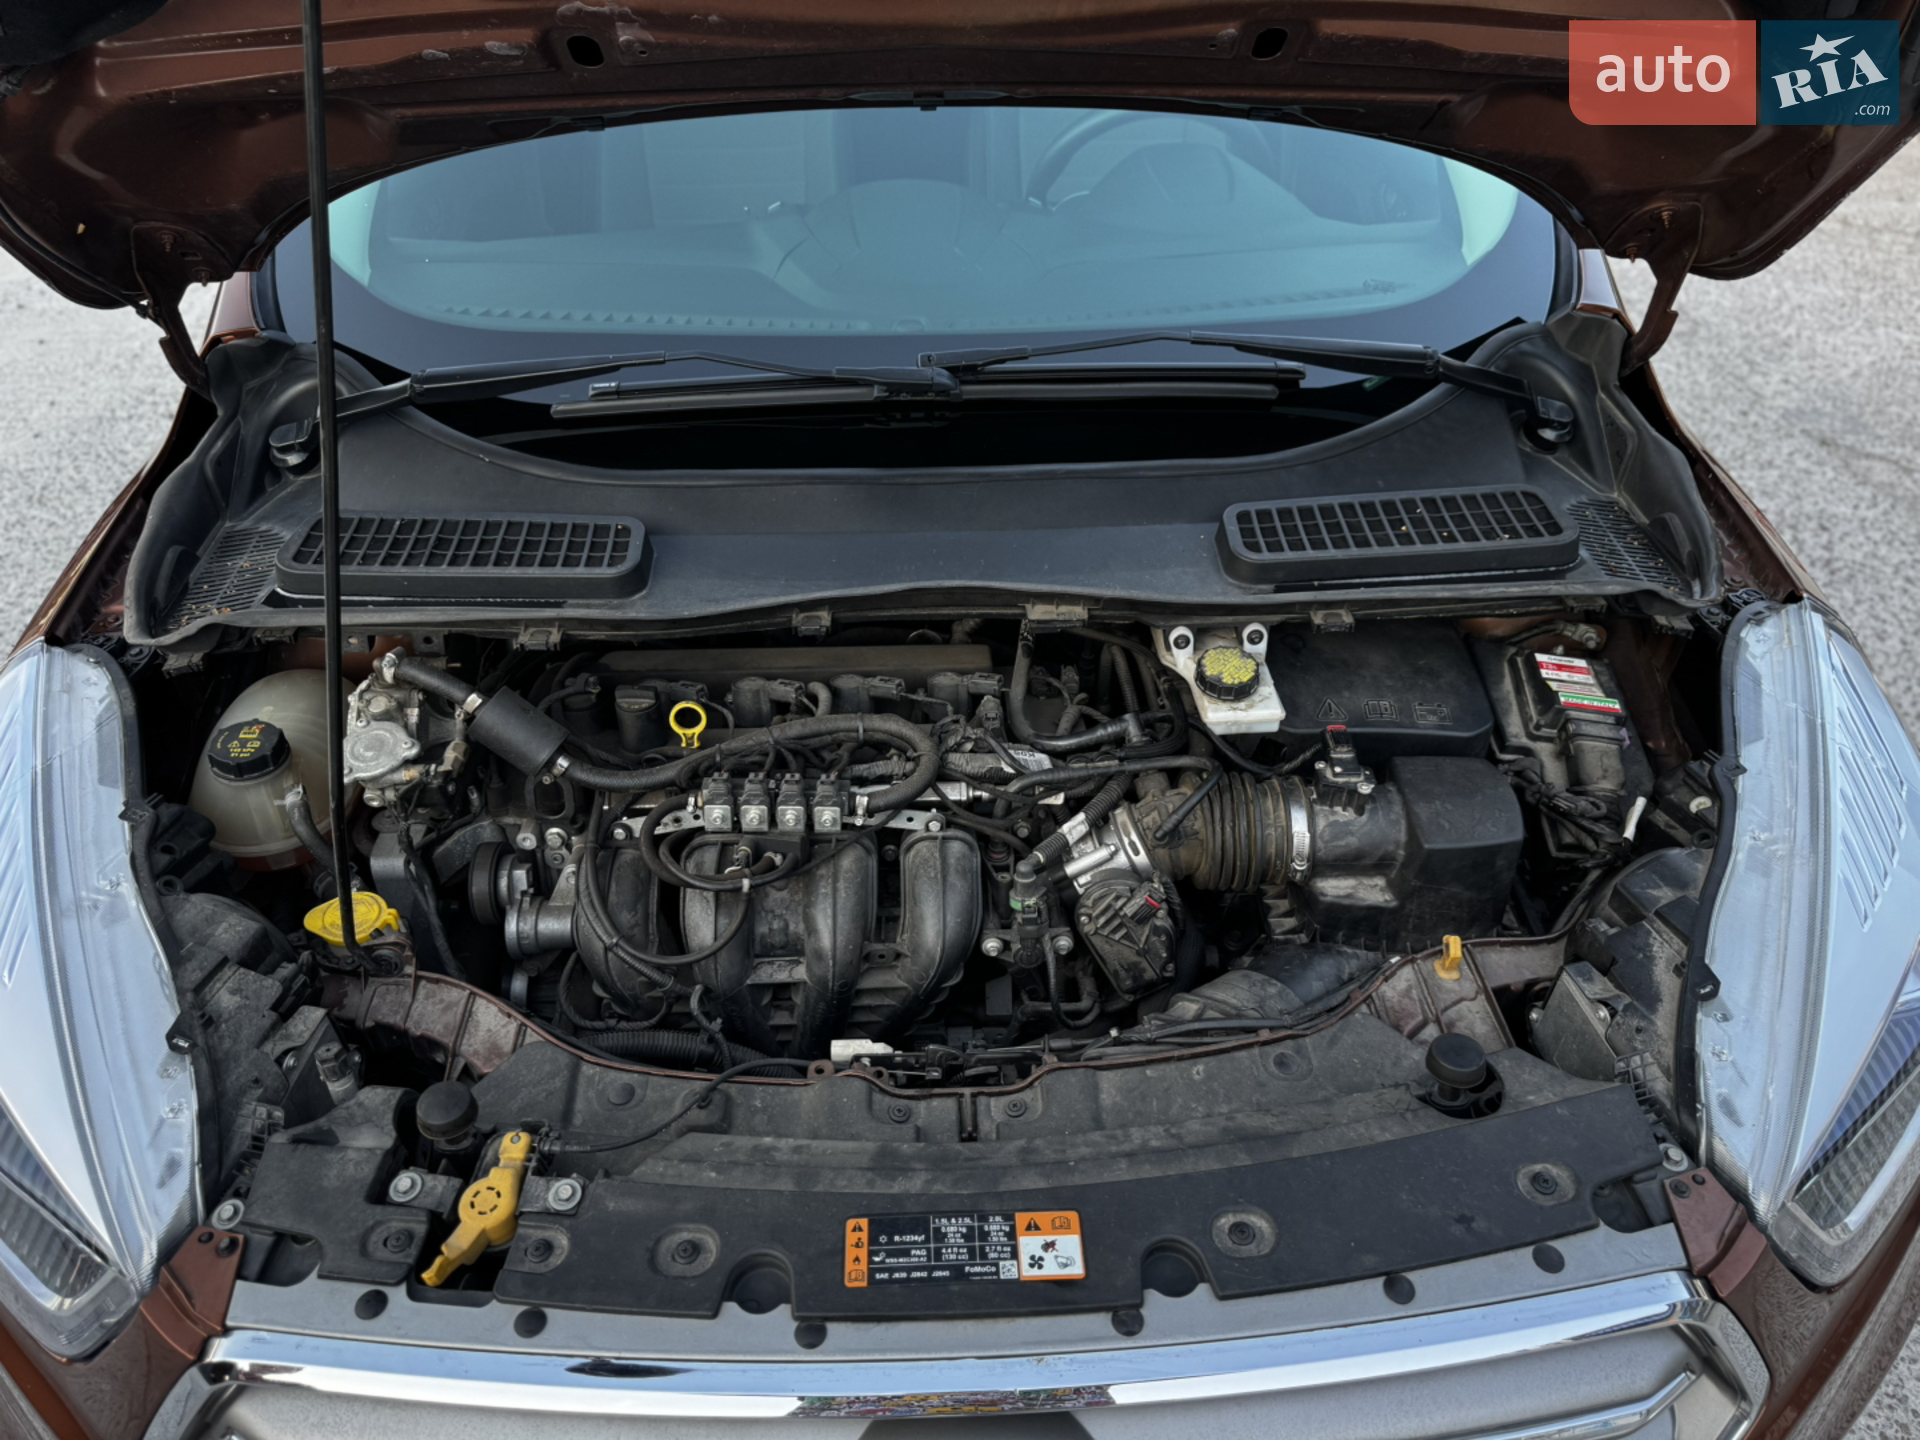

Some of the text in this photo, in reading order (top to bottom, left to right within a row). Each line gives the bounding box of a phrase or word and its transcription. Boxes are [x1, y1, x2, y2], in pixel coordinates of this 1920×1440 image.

[950, 1216, 957, 1224] &
[1001, 1224, 1010, 1232] kg
[893, 1234, 925, 1242] R-1234yf
[964, 1265, 997, 1273] FoMoCo
